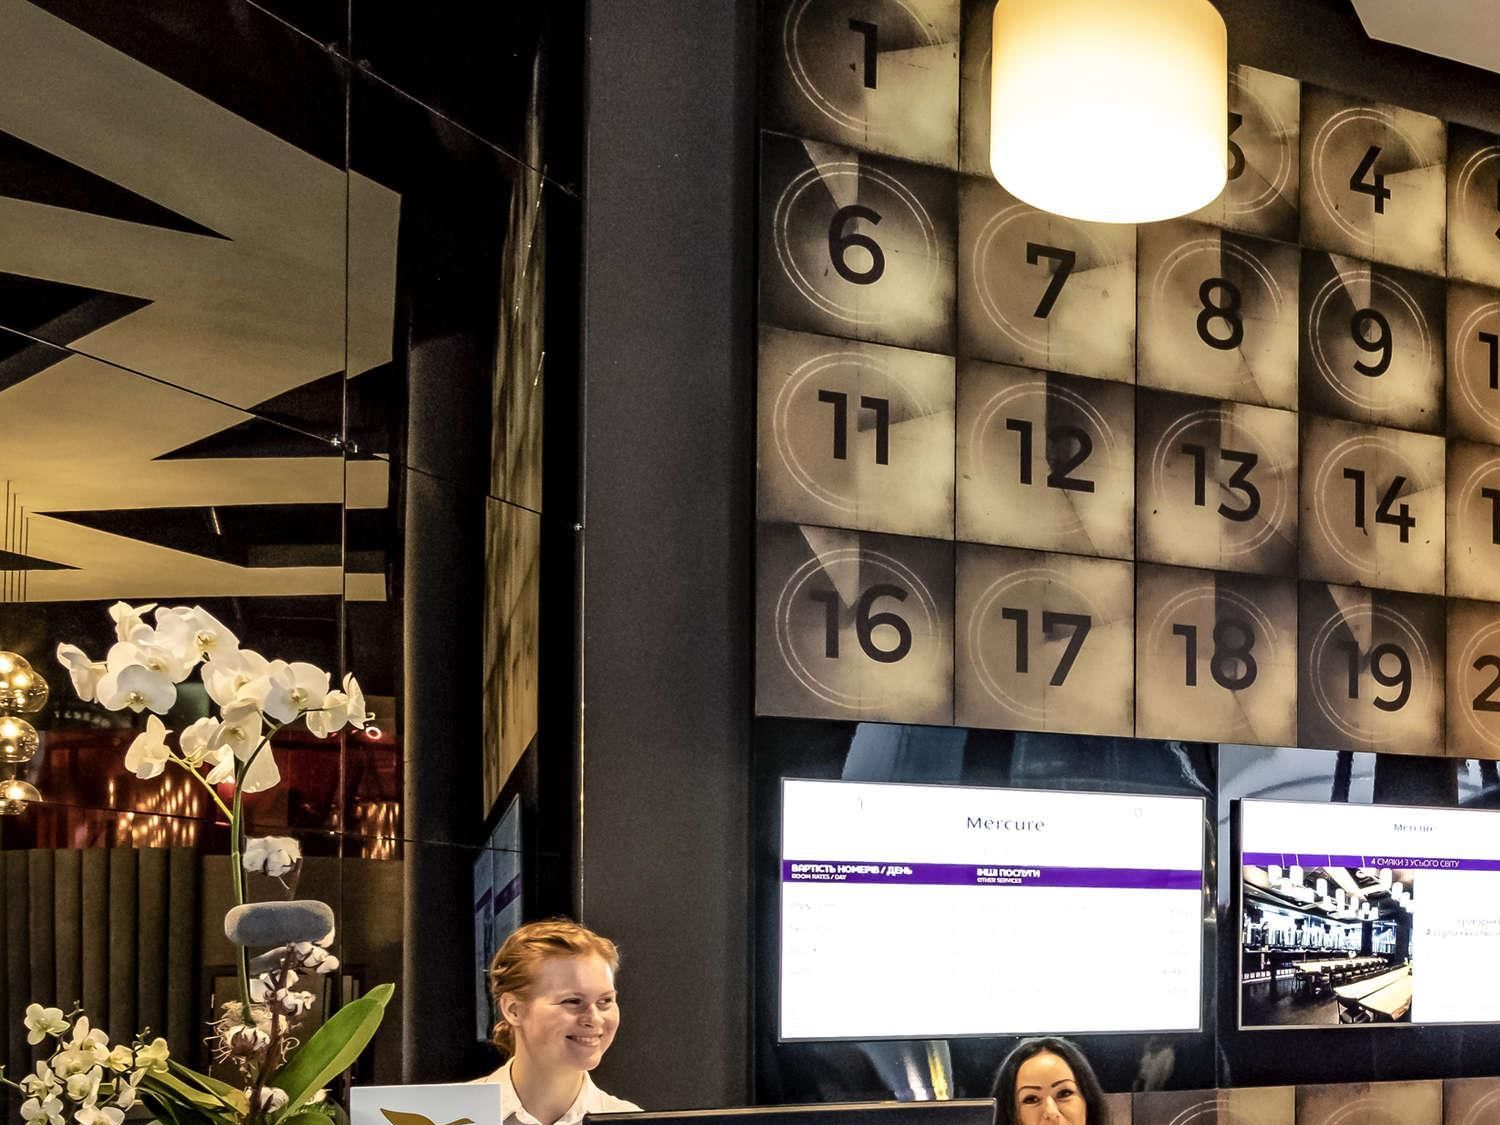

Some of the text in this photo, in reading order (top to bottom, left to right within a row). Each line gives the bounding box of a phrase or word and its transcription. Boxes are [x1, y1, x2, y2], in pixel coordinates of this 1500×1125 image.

[849, 19, 878, 89] 1
[1349, 146, 1390, 215] 4
[829, 205, 886, 285] 6
[1026, 243, 1076, 319] 7
[1196, 277, 1243, 350] 8
[1351, 308, 1392, 377] 9
[818, 390, 889, 465] 11
[1006, 419, 1094, 492] 12
[1181, 443, 1261, 521] 13
[1343, 468, 1415, 543] 14
[810, 583, 912, 663] 16
[1001, 607, 1091, 686] 17
[1172, 619, 1257, 691] 18
[1345, 640, 1412, 712] 19
[967, 816, 1046, 831] Mercure
